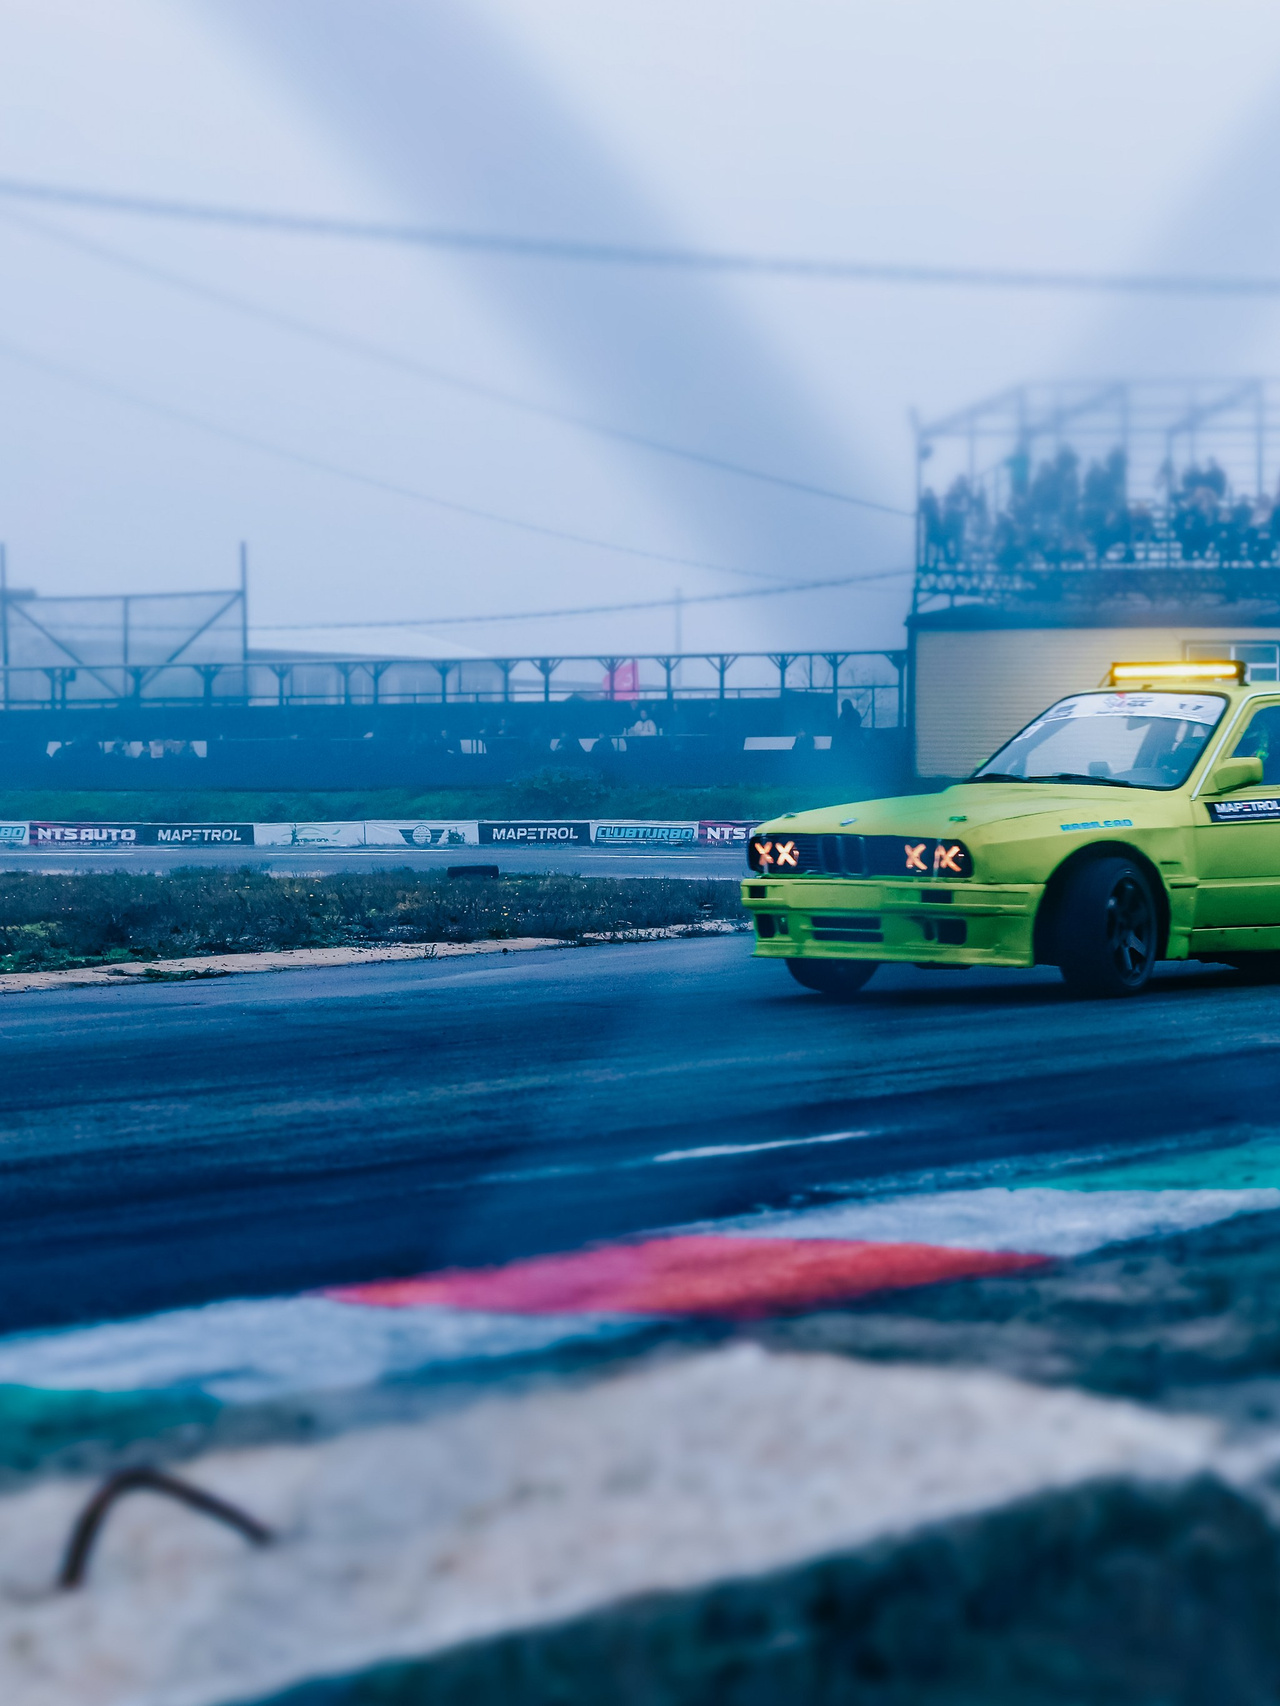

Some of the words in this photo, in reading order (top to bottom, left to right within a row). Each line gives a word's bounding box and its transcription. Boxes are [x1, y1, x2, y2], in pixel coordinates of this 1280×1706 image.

[157, 829, 242, 841] MAPETROL
[492, 827, 579, 840] MAPETROL
[596, 826, 695, 840] CLUBTURBO
